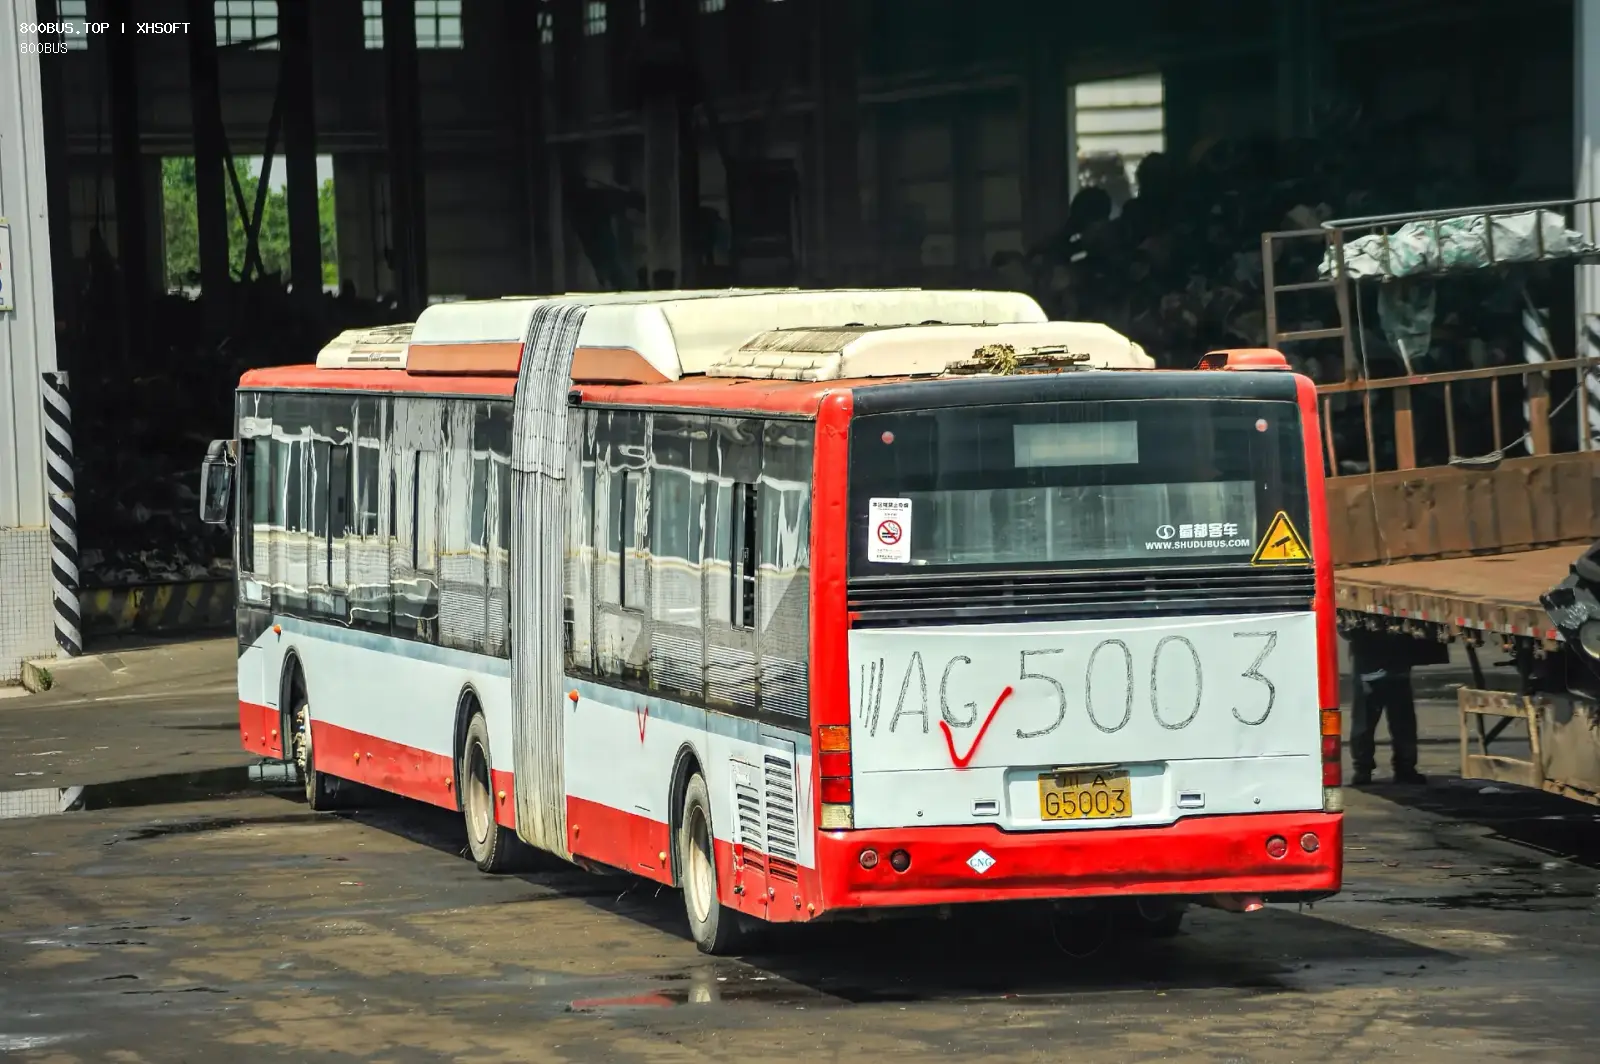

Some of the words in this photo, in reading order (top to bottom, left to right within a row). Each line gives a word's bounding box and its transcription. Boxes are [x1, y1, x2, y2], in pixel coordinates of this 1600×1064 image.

[1179, 522, 1238, 539] 蜀都客车
[1145, 538, 1250, 550] WWW.SHUDUBUS.COM
[1045, 789, 1125, 816] G5003
[969, 858, 992, 867] CNG
